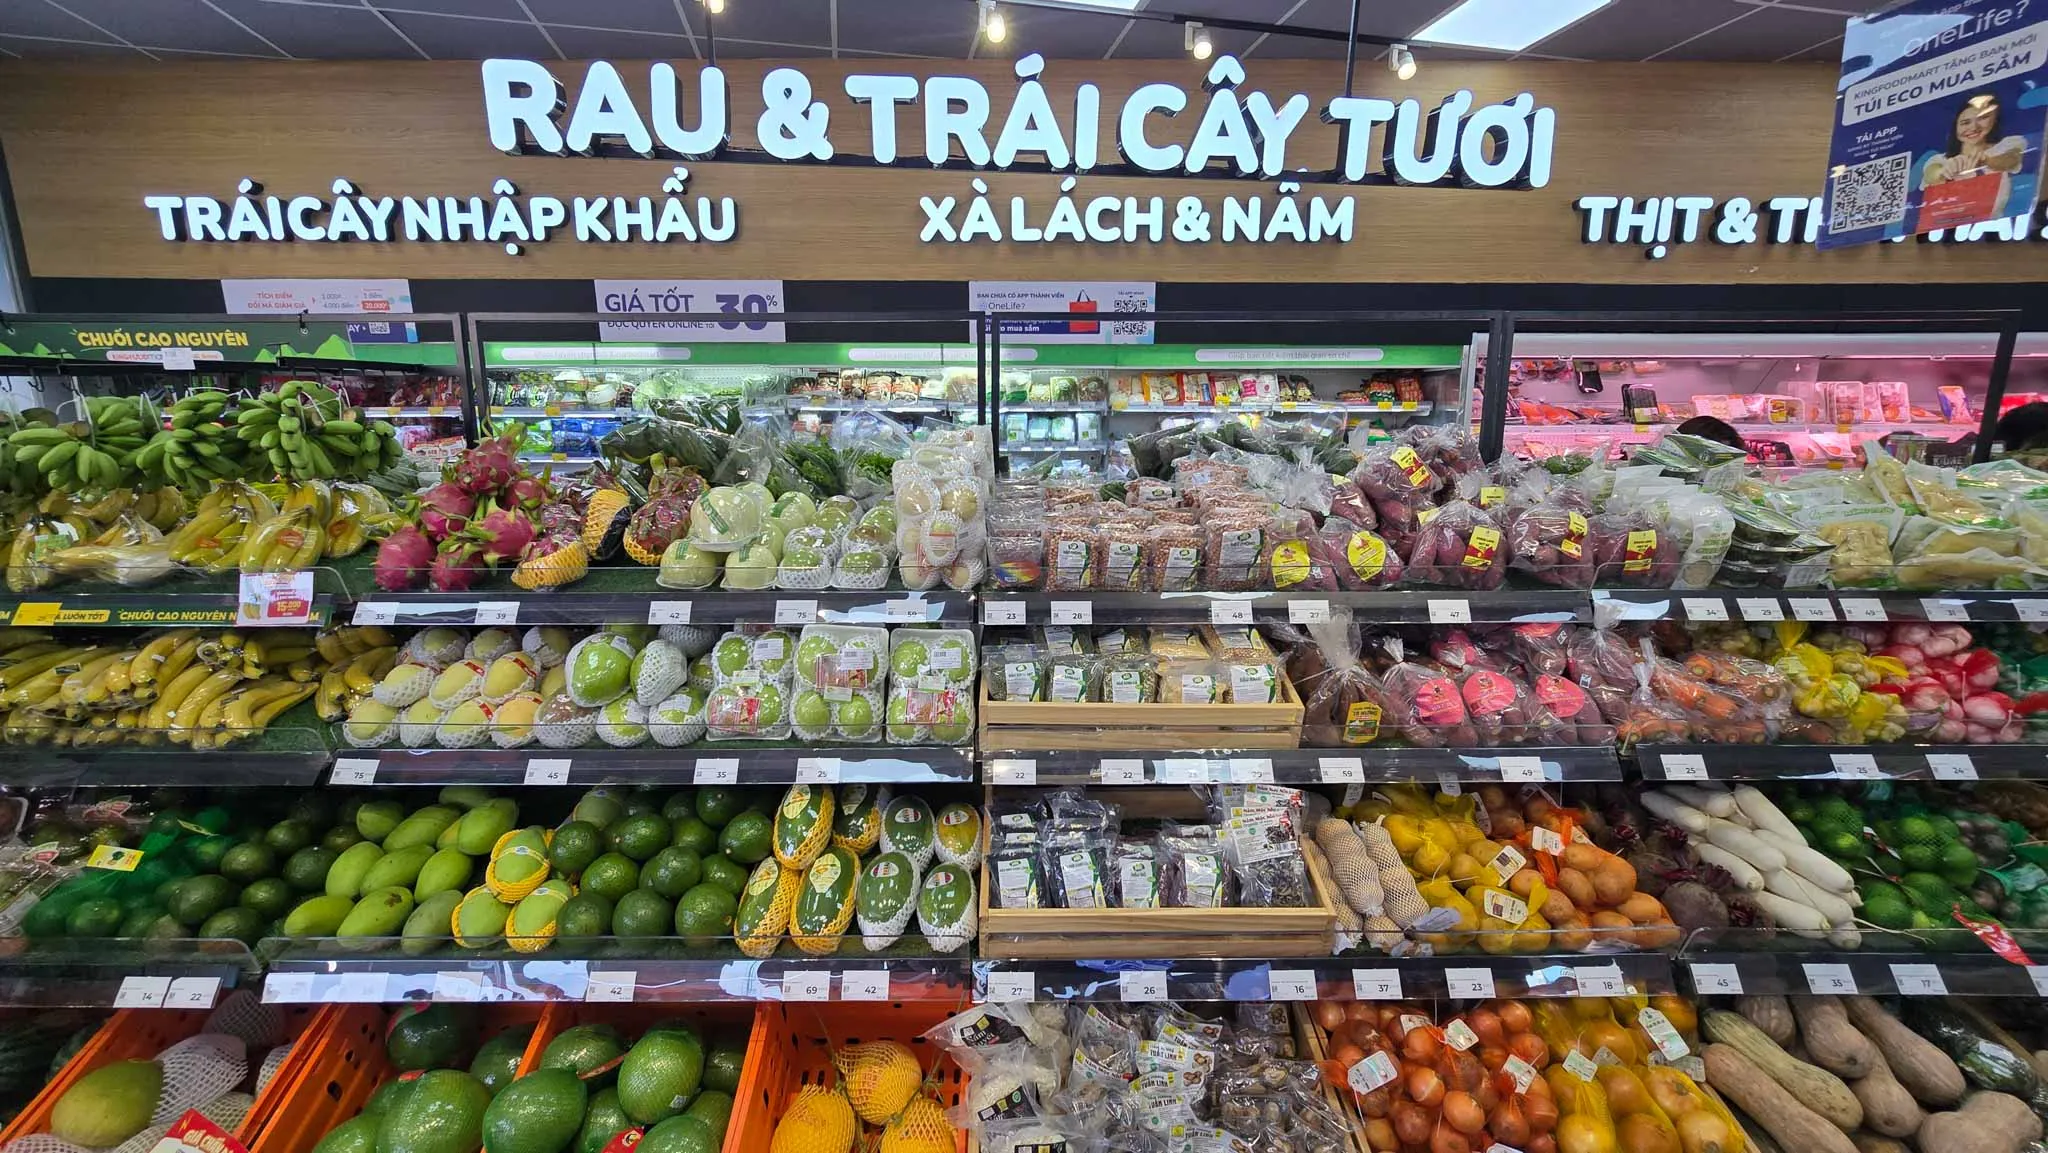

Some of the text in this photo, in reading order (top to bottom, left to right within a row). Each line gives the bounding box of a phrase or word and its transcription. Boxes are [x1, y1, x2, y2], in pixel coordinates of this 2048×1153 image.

[1854, 66, 1940, 100] KINGFOODMART
[1854, 51, 2031, 116] TÚI ECO MUA SẮM
[482, 52, 1556, 188] RAU & TRÁI CÂY TƯƠI
[1856, 131, 1872, 144] TẢI
[1874, 126, 1898, 139] APP
[145, 166, 736, 256] TRÁI CÂY NHẬP KHẨU
[919, 177, 1002, 242] XÀ
[1011, 176, 1163, 242] LÁCH
[1171, 196, 1211, 242] &
[1578, 196, 1714, 258] THỊT
[1717, 197, 1758, 244] &
[605, 286, 694, 312] GIÁ TỐT
[988, 301, 1026, 310] OneLife?
[77, 327, 249, 347] CHUỐI CAO NGUYÊN
[120, 609, 154, 621] CHUỐI
[156, 612, 179, 621] CAO
[181, 609, 227, 621] NGUYÊN
[354, 771, 365, 779] 75
[716, 771, 727, 779] 35
[1472, 983, 1483, 991] 23
[1603, 981, 1613, 990] 18
[1717, 979, 1729, 987] 45
[610, 987, 622, 995] 42
[806, 986, 818, 995] 69
[865, 986, 877, 994] 42
[1011, 987, 1023, 995] 27
[1143, 986, 1156, 995] 26
[1295, 985, 1305, 994] 16
[1378, 984, 1389, 993] 37
[190, 992, 202, 1001] 22
